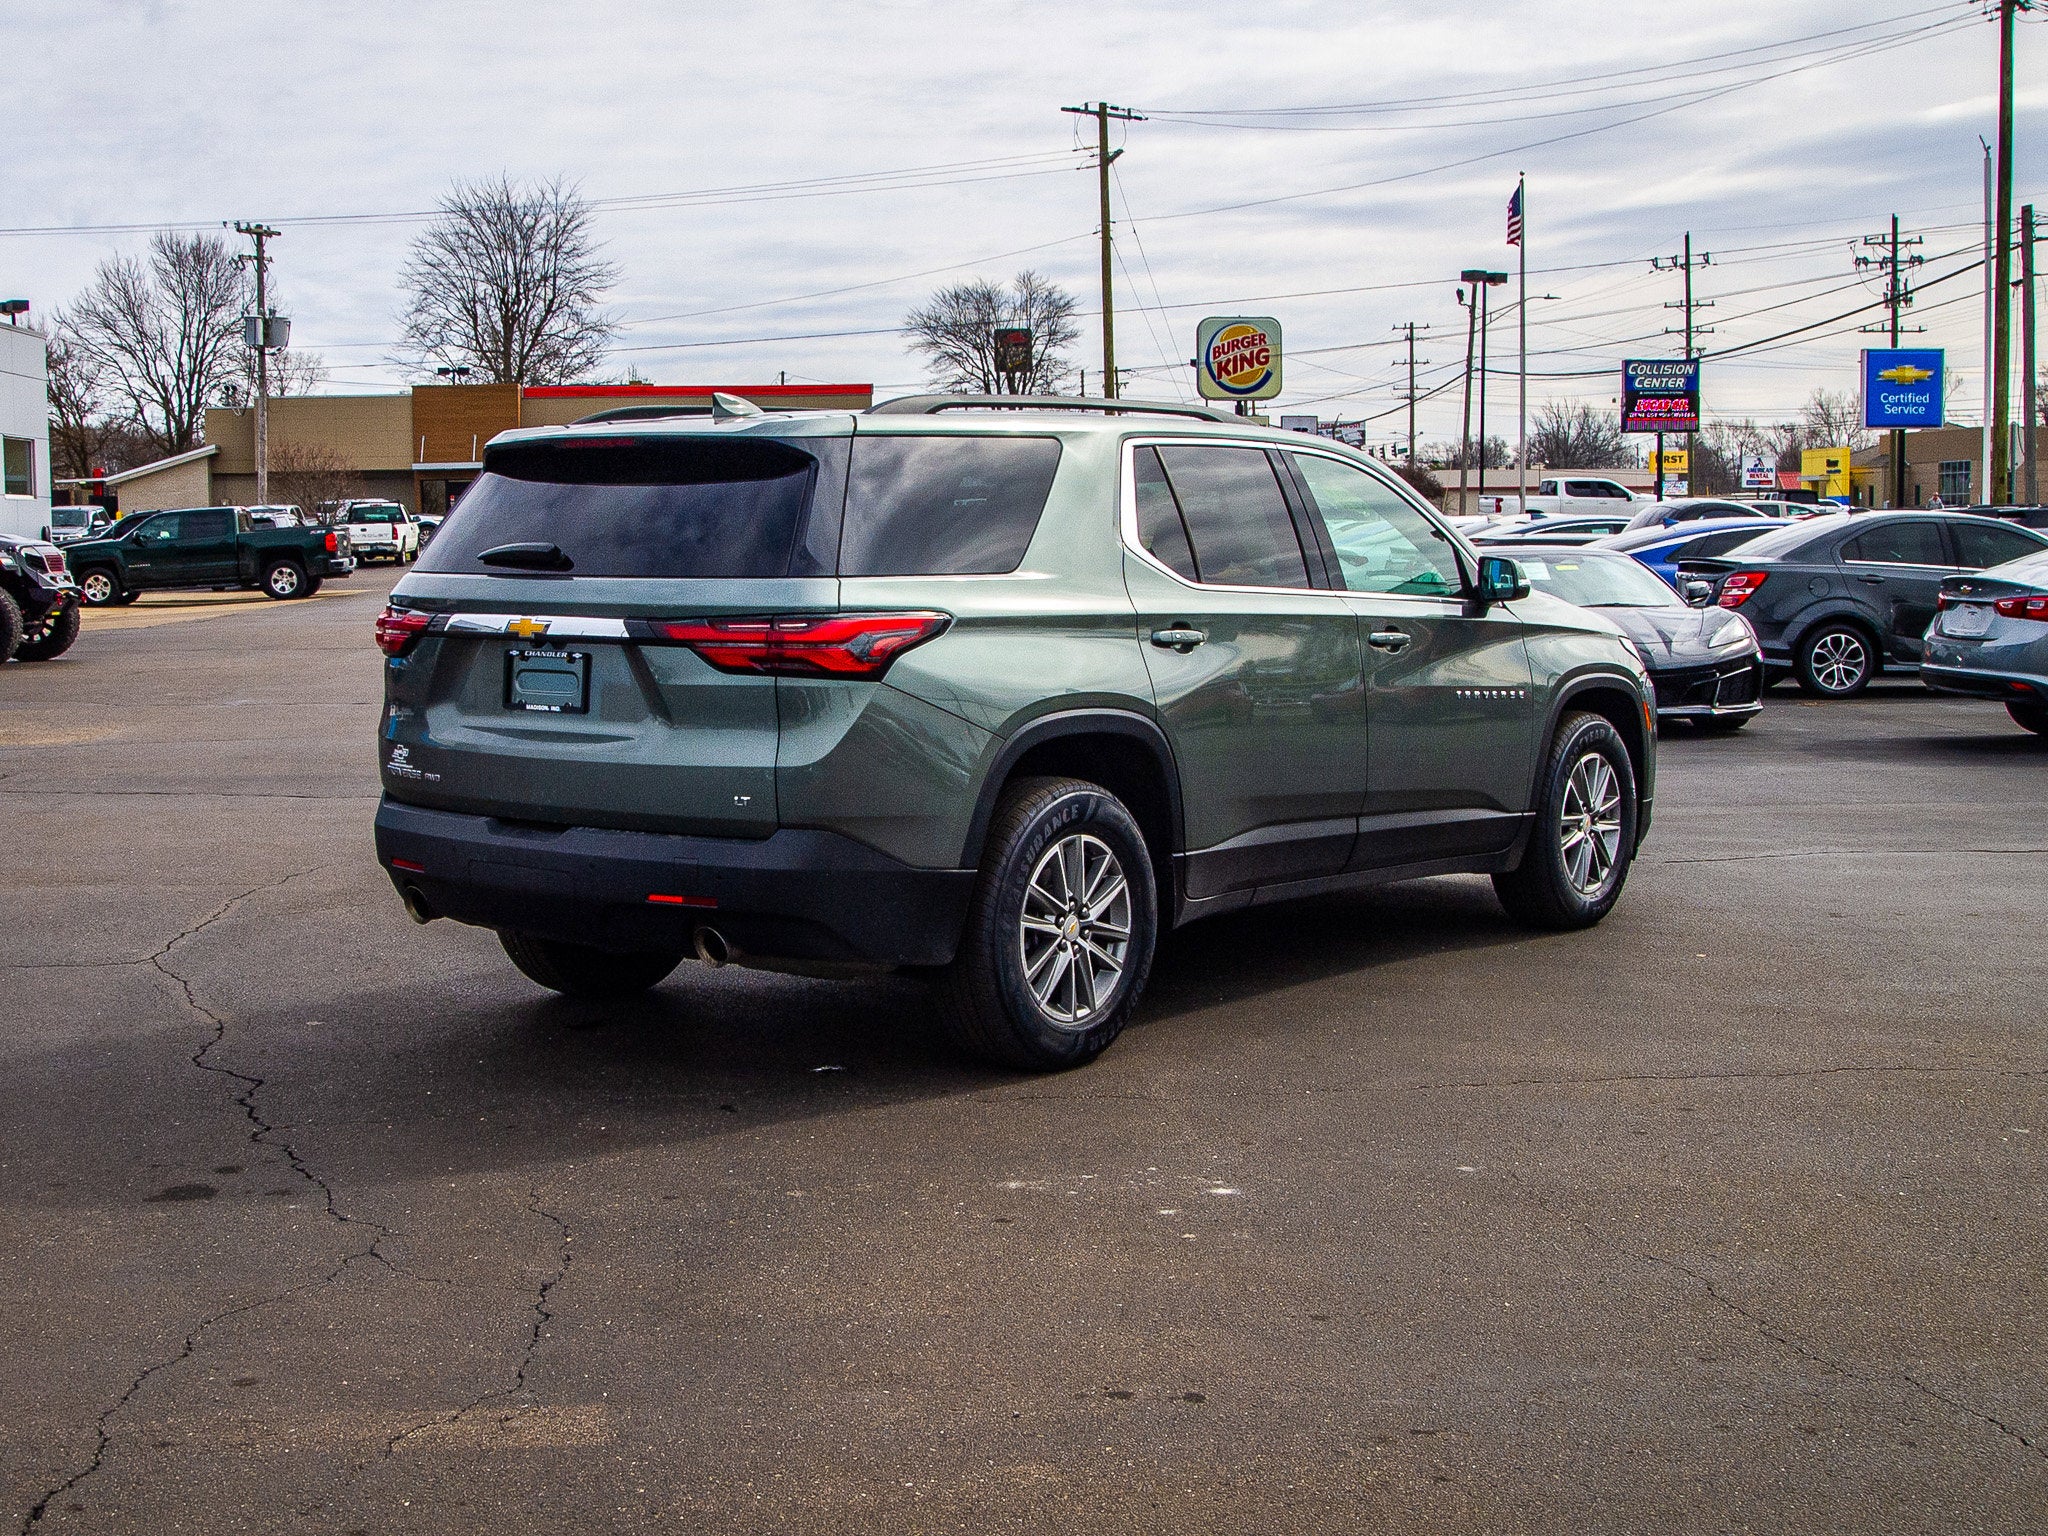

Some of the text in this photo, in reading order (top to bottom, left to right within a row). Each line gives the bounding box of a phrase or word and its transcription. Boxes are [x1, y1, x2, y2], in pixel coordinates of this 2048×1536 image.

[1212, 332, 1267, 361] BURGER
[1216, 347, 1270, 380] KING
[1628, 363, 1695, 375] COLLISION
[1634, 377, 1685, 388] CENTER
[1880, 392, 1930, 403] Certified
[1884, 404, 1926, 414] Service
[1663, 455, 1684, 463] RST
[524, 650, 568, 658] CHANDLER
[733, 795, 751, 806] LT
